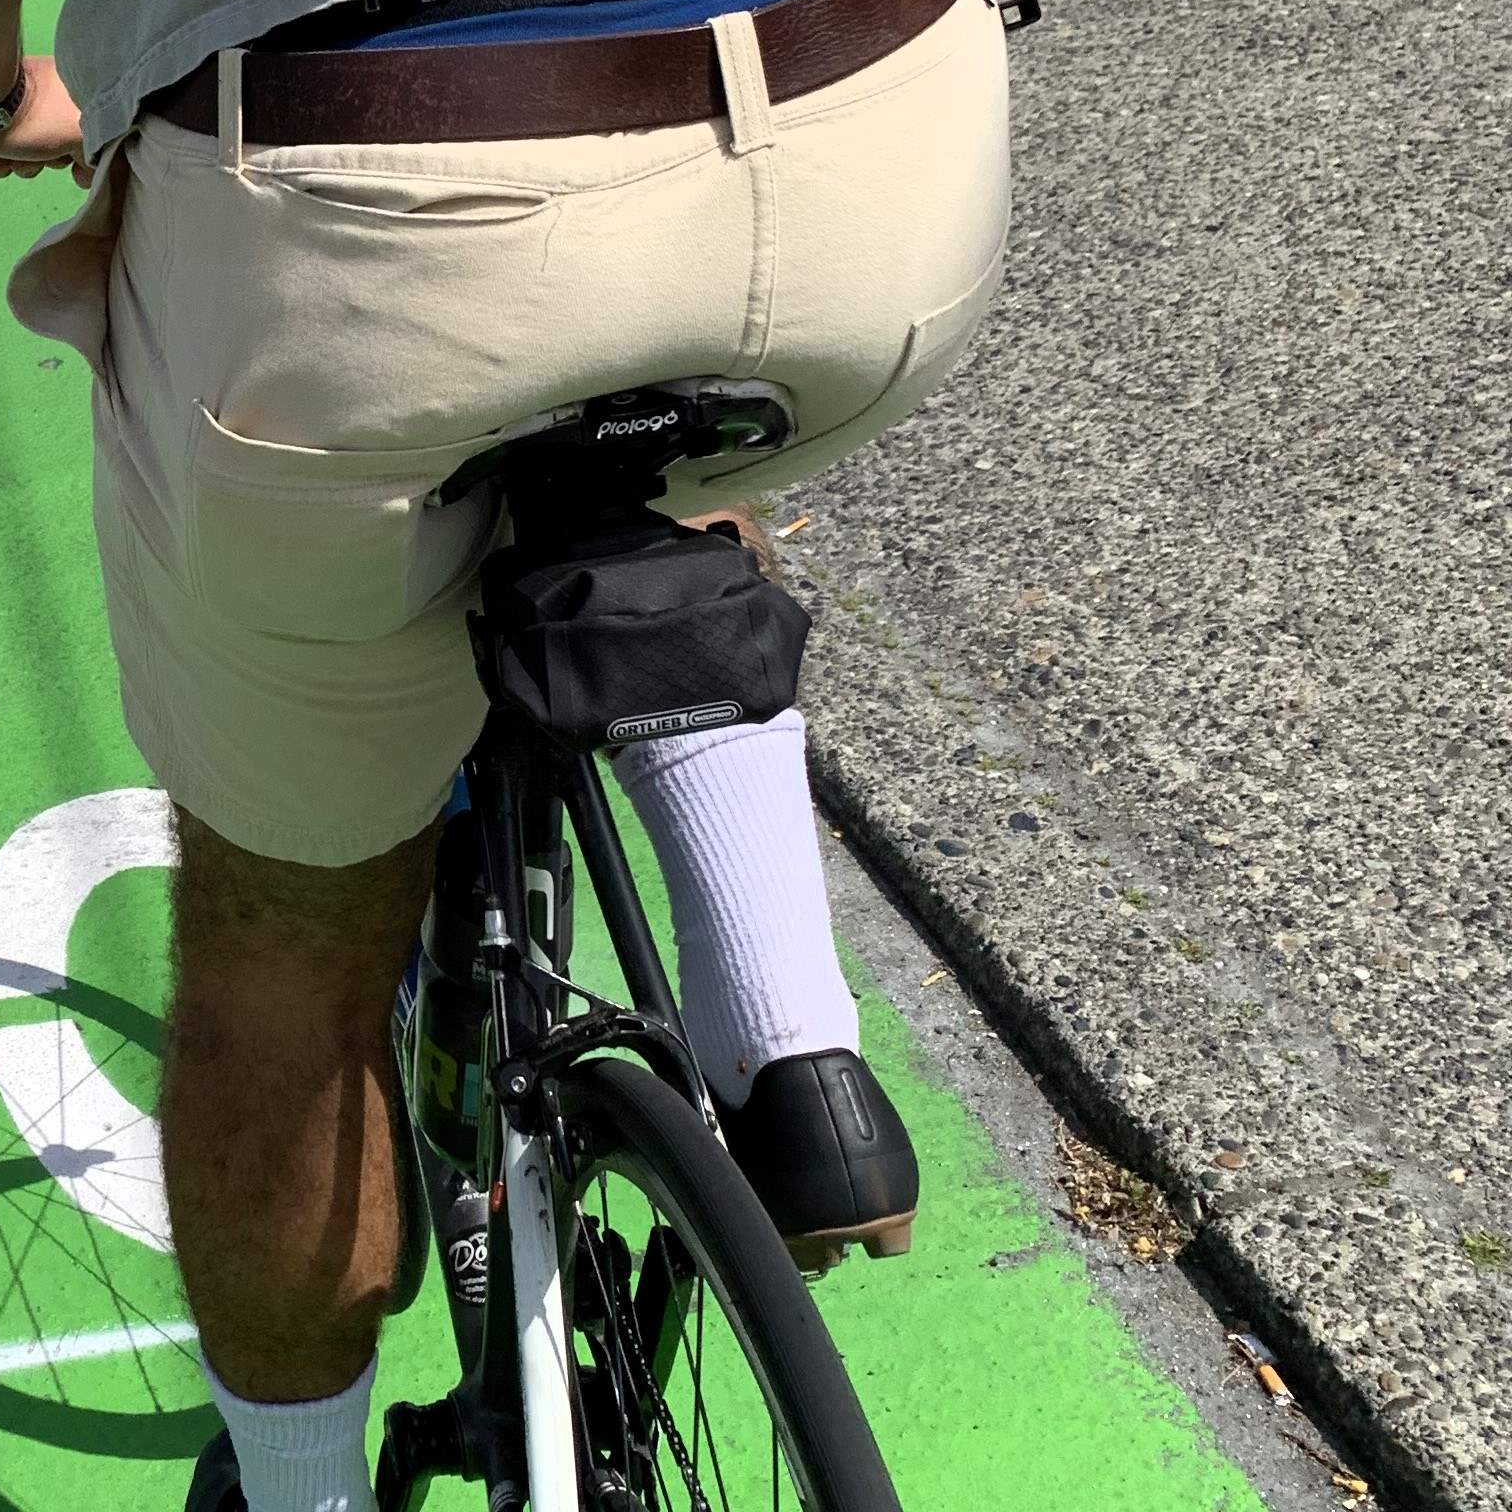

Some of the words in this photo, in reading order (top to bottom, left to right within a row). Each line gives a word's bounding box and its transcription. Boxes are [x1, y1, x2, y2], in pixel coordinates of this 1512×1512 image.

[596, 409, 679, 440] prologo
[615, 717, 682, 737] ORTLIEB
[694, 710, 733, 722] WATERPROOF
